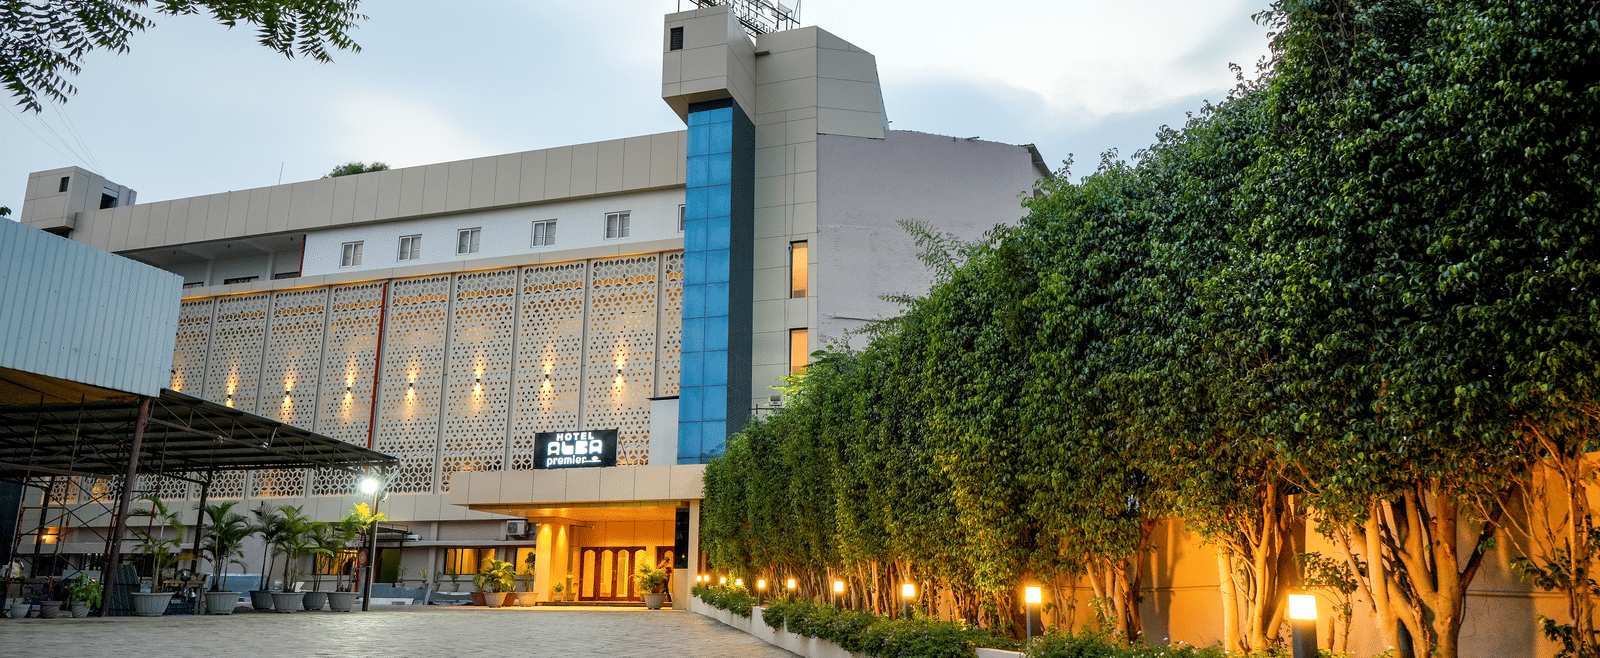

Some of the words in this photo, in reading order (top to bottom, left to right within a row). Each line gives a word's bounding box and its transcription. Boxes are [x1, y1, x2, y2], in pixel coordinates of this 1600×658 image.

[556, 431, 595, 441] HOTEL
[547, 439, 603, 456] ALBA
[546, 455, 587, 467] premier
